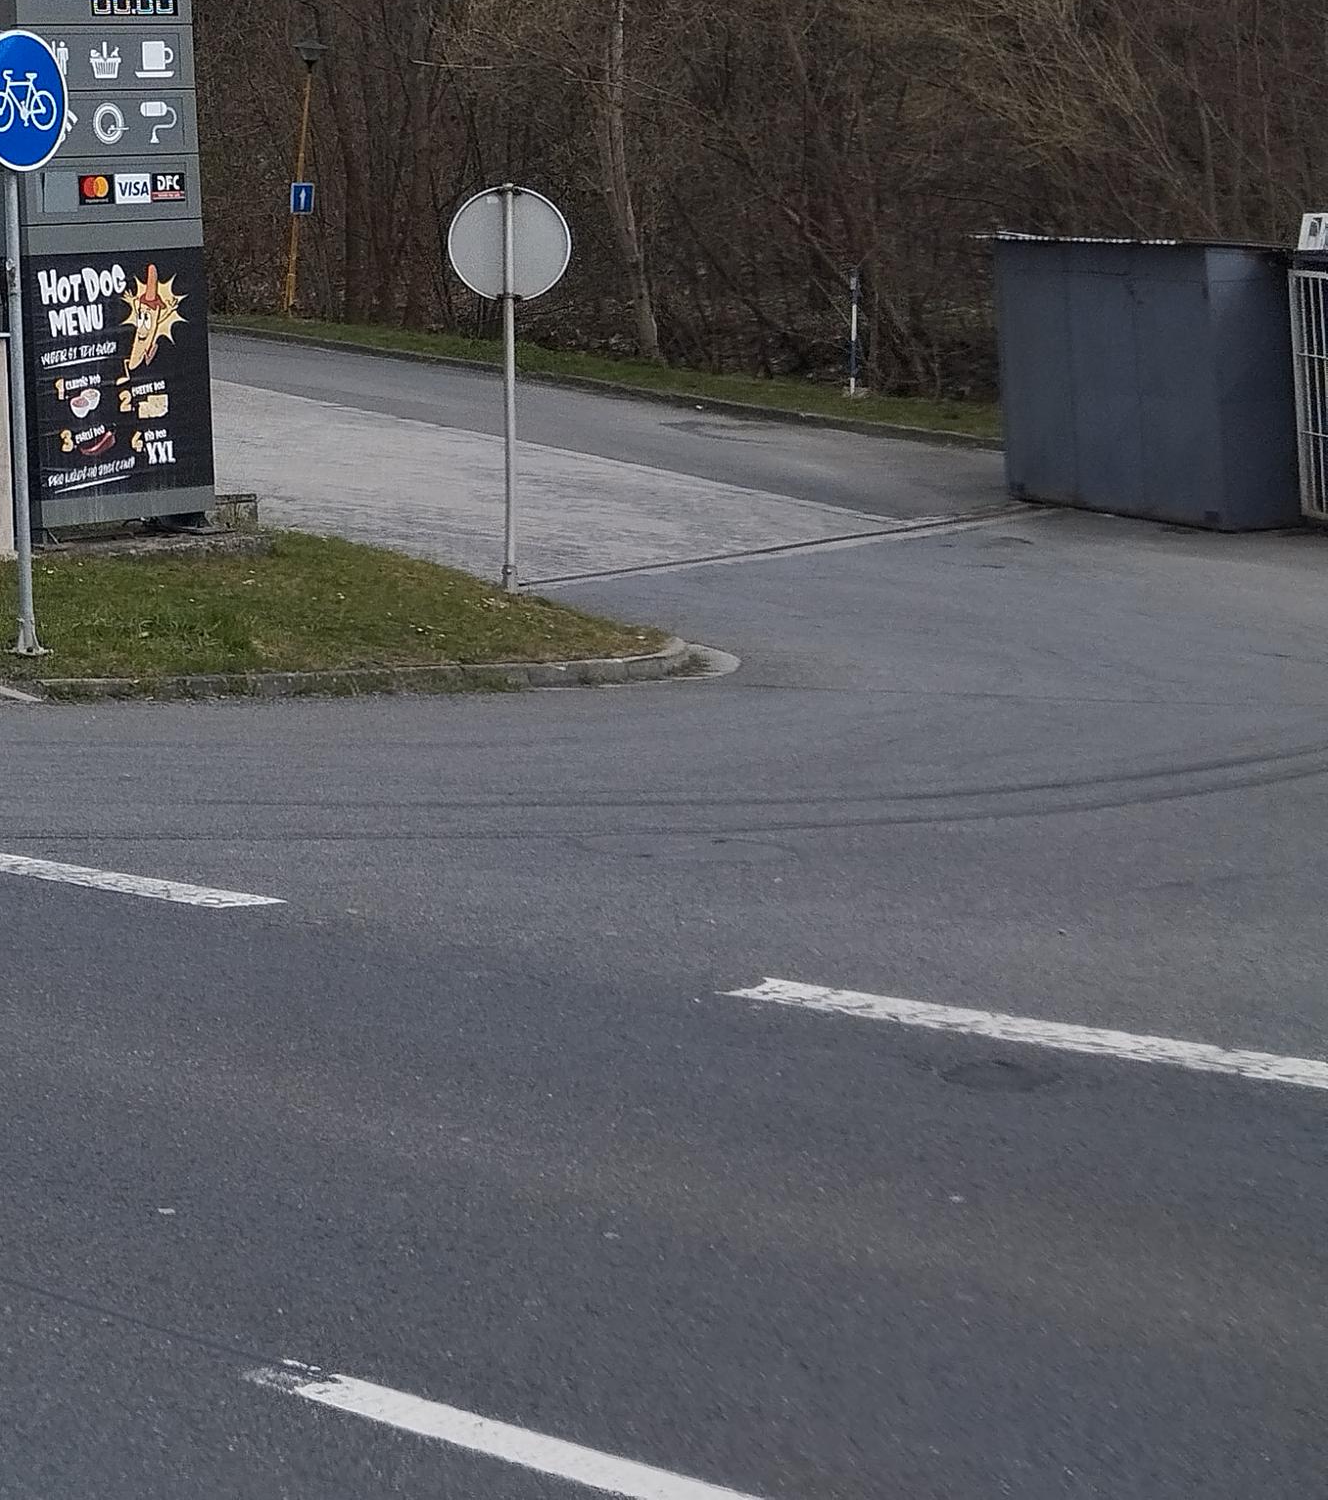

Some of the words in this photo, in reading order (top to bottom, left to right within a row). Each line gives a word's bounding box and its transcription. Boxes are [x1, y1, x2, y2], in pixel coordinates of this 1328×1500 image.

[118, 181, 150, 197] VISA
[48, 304, 104, 338] MENU
[146, 440, 176, 464] XXL
